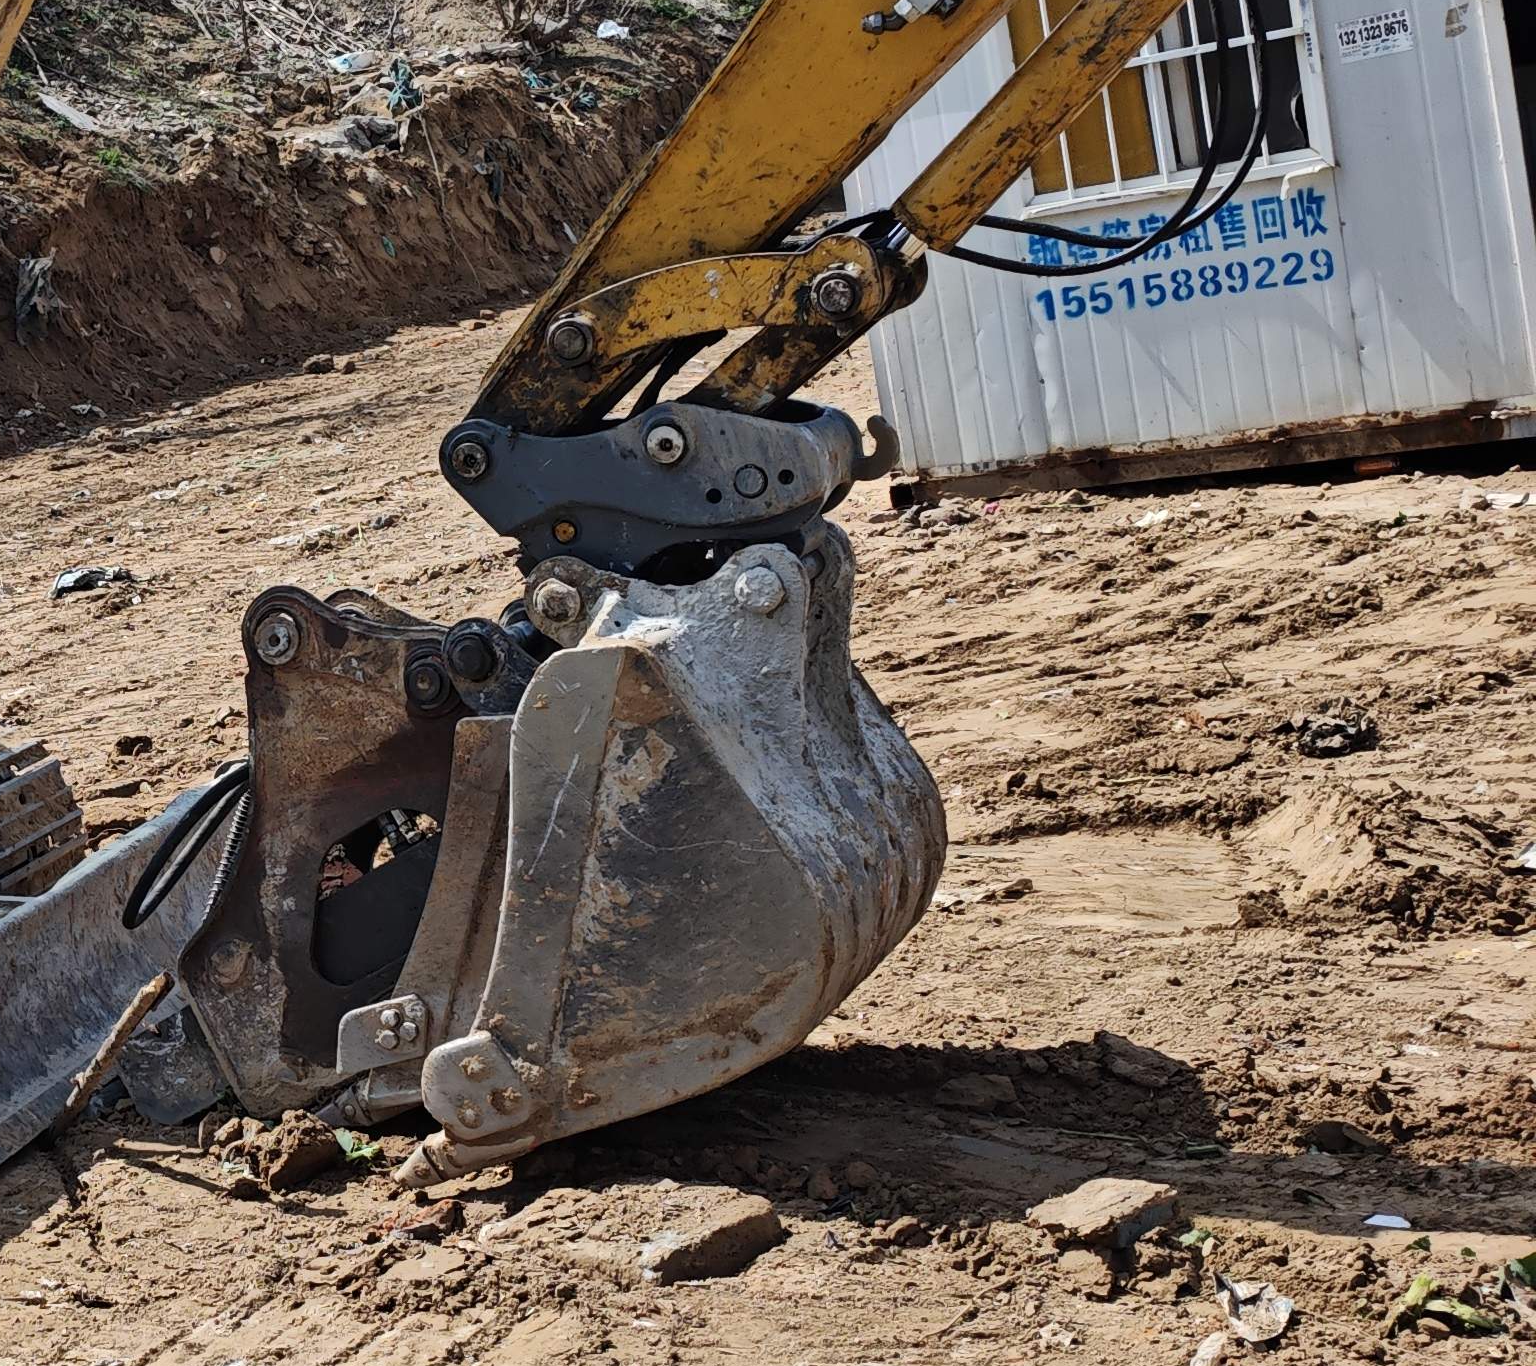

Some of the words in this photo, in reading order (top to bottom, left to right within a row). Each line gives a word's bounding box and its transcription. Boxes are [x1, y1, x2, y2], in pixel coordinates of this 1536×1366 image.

[1338, 29, 1358, 47] 132
[1358, 24, 1383, 42] 1323
[1383, 19, 1409, 37] 8676
[1036, 248, 1335, 321] 15515889229
